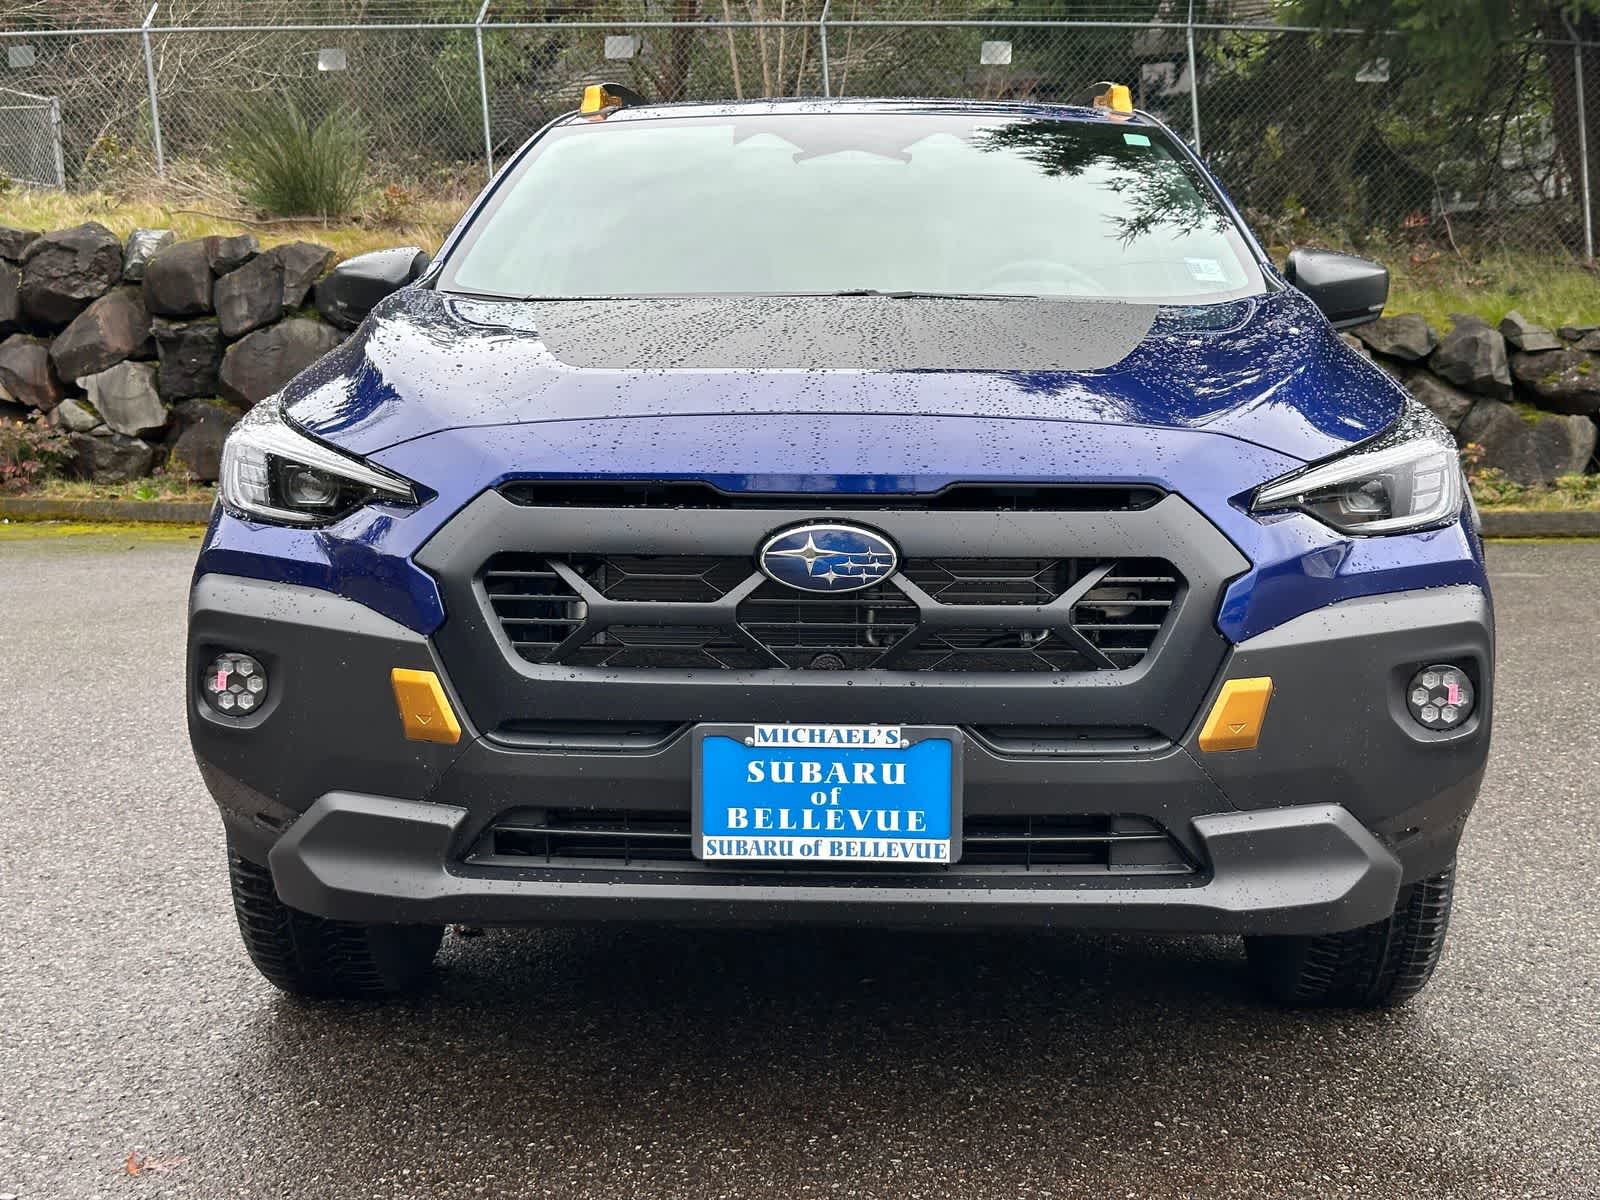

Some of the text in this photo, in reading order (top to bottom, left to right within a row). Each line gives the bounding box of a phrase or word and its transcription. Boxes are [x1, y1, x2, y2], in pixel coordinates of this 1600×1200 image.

[757, 728, 899, 744] MICHAEL'S
[746, 760, 906, 785] SUBARU
[810, 787, 842, 805] of
[727, 807, 927, 832] BELLEVUE
[706, 839, 947, 859] SUBARU of BELLEVUE
